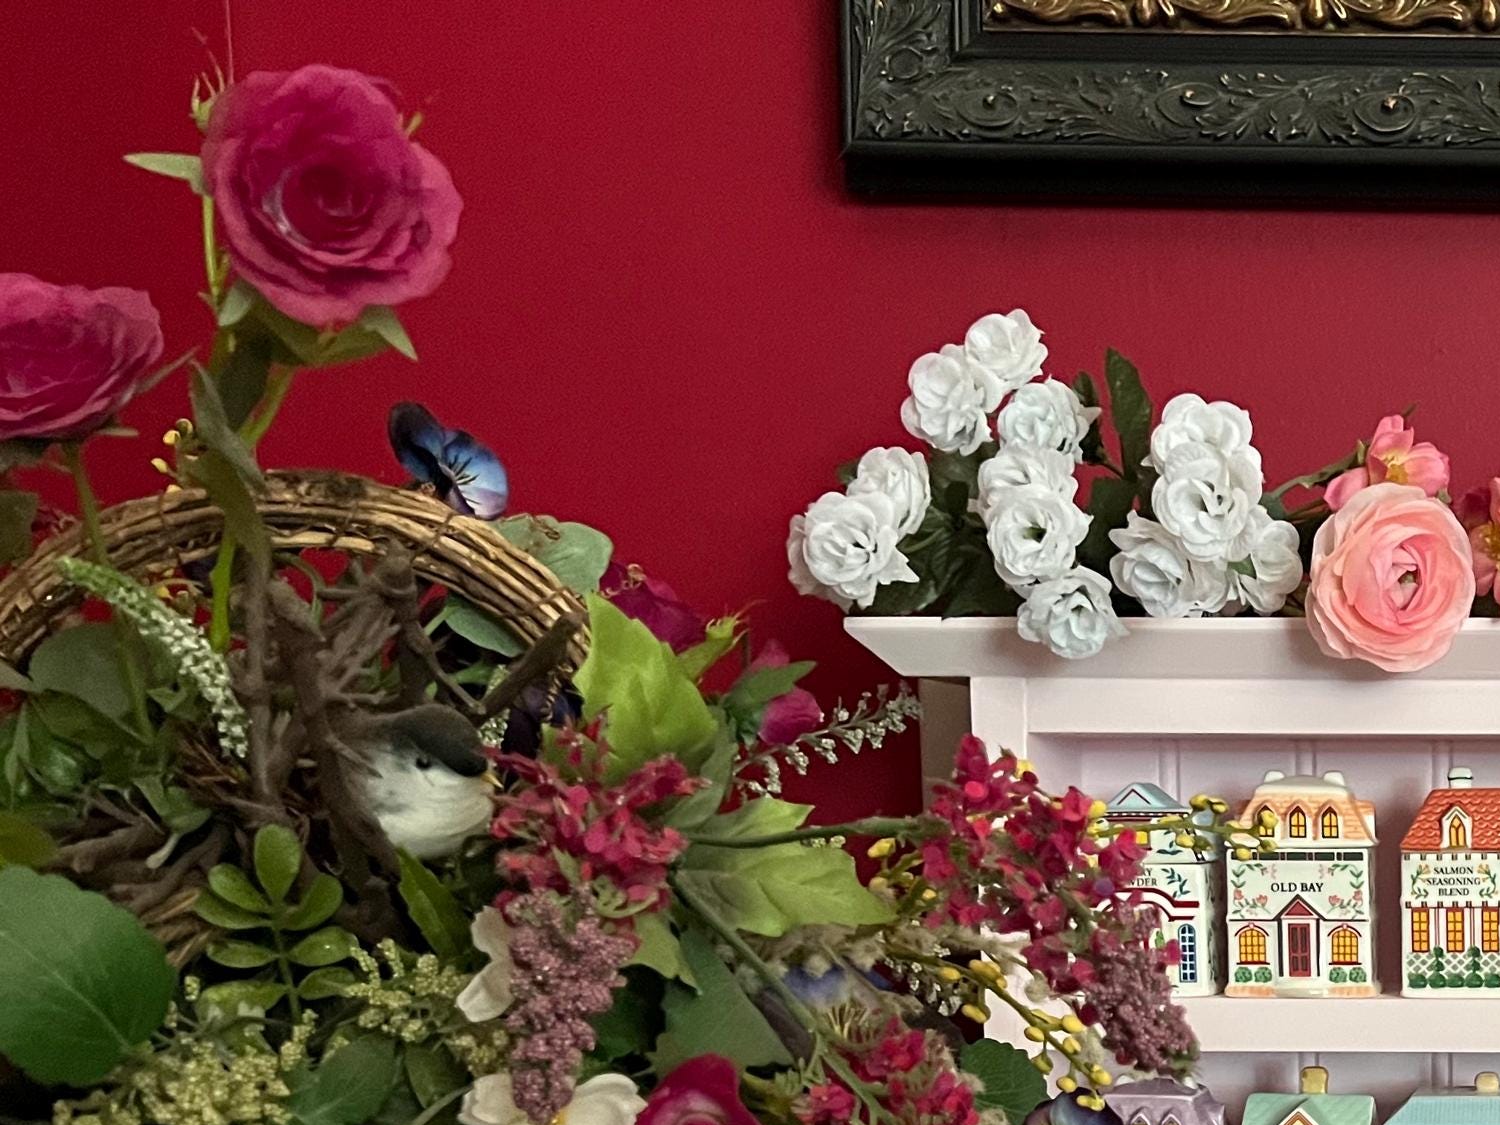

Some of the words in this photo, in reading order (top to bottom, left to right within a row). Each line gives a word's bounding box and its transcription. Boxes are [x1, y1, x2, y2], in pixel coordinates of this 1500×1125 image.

[1433, 866, 1474, 875] SALMON
[1426, 877, 1481, 886] SEASONING
[1270, 882, 1298, 893] OLD
[1300, 882, 1324, 893] BAY
[1438, 887, 1470, 897] BLEND
